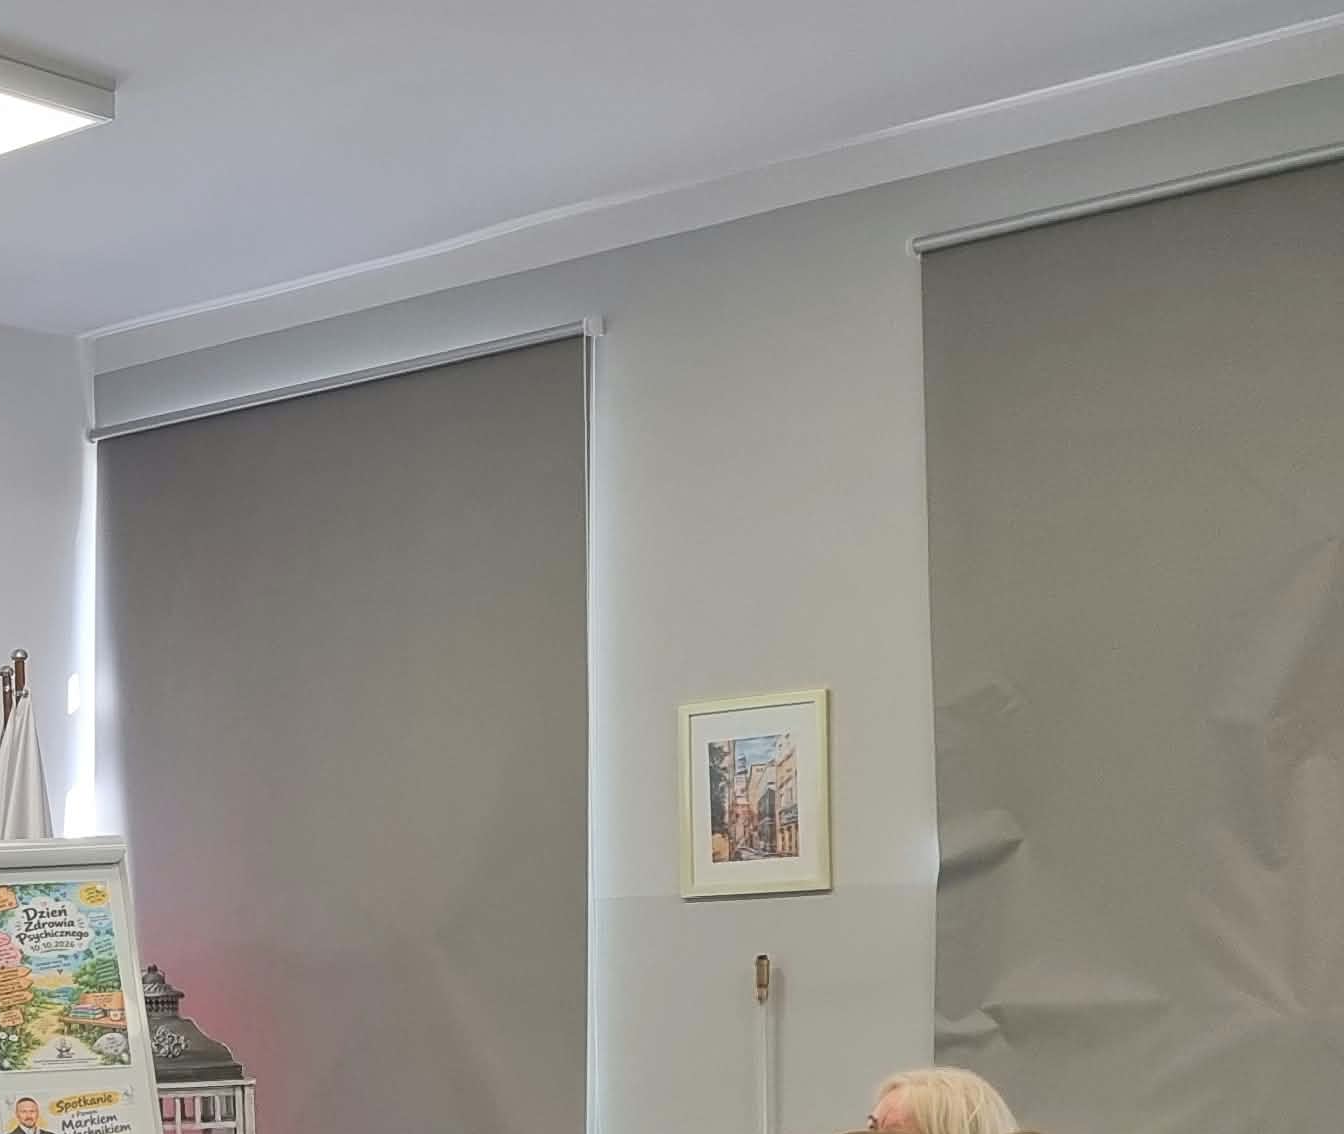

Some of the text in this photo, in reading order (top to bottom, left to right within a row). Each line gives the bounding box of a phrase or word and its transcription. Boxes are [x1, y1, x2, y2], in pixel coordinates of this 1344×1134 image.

[23, 905, 67, 921] Dzień
[24, 919, 75, 932] Zdrowia
[16, 929, 89, 945] Psychicznego
[56, 1094, 113, 1113] Spotkanie
[61, 1115, 117, 1131] Markiem
